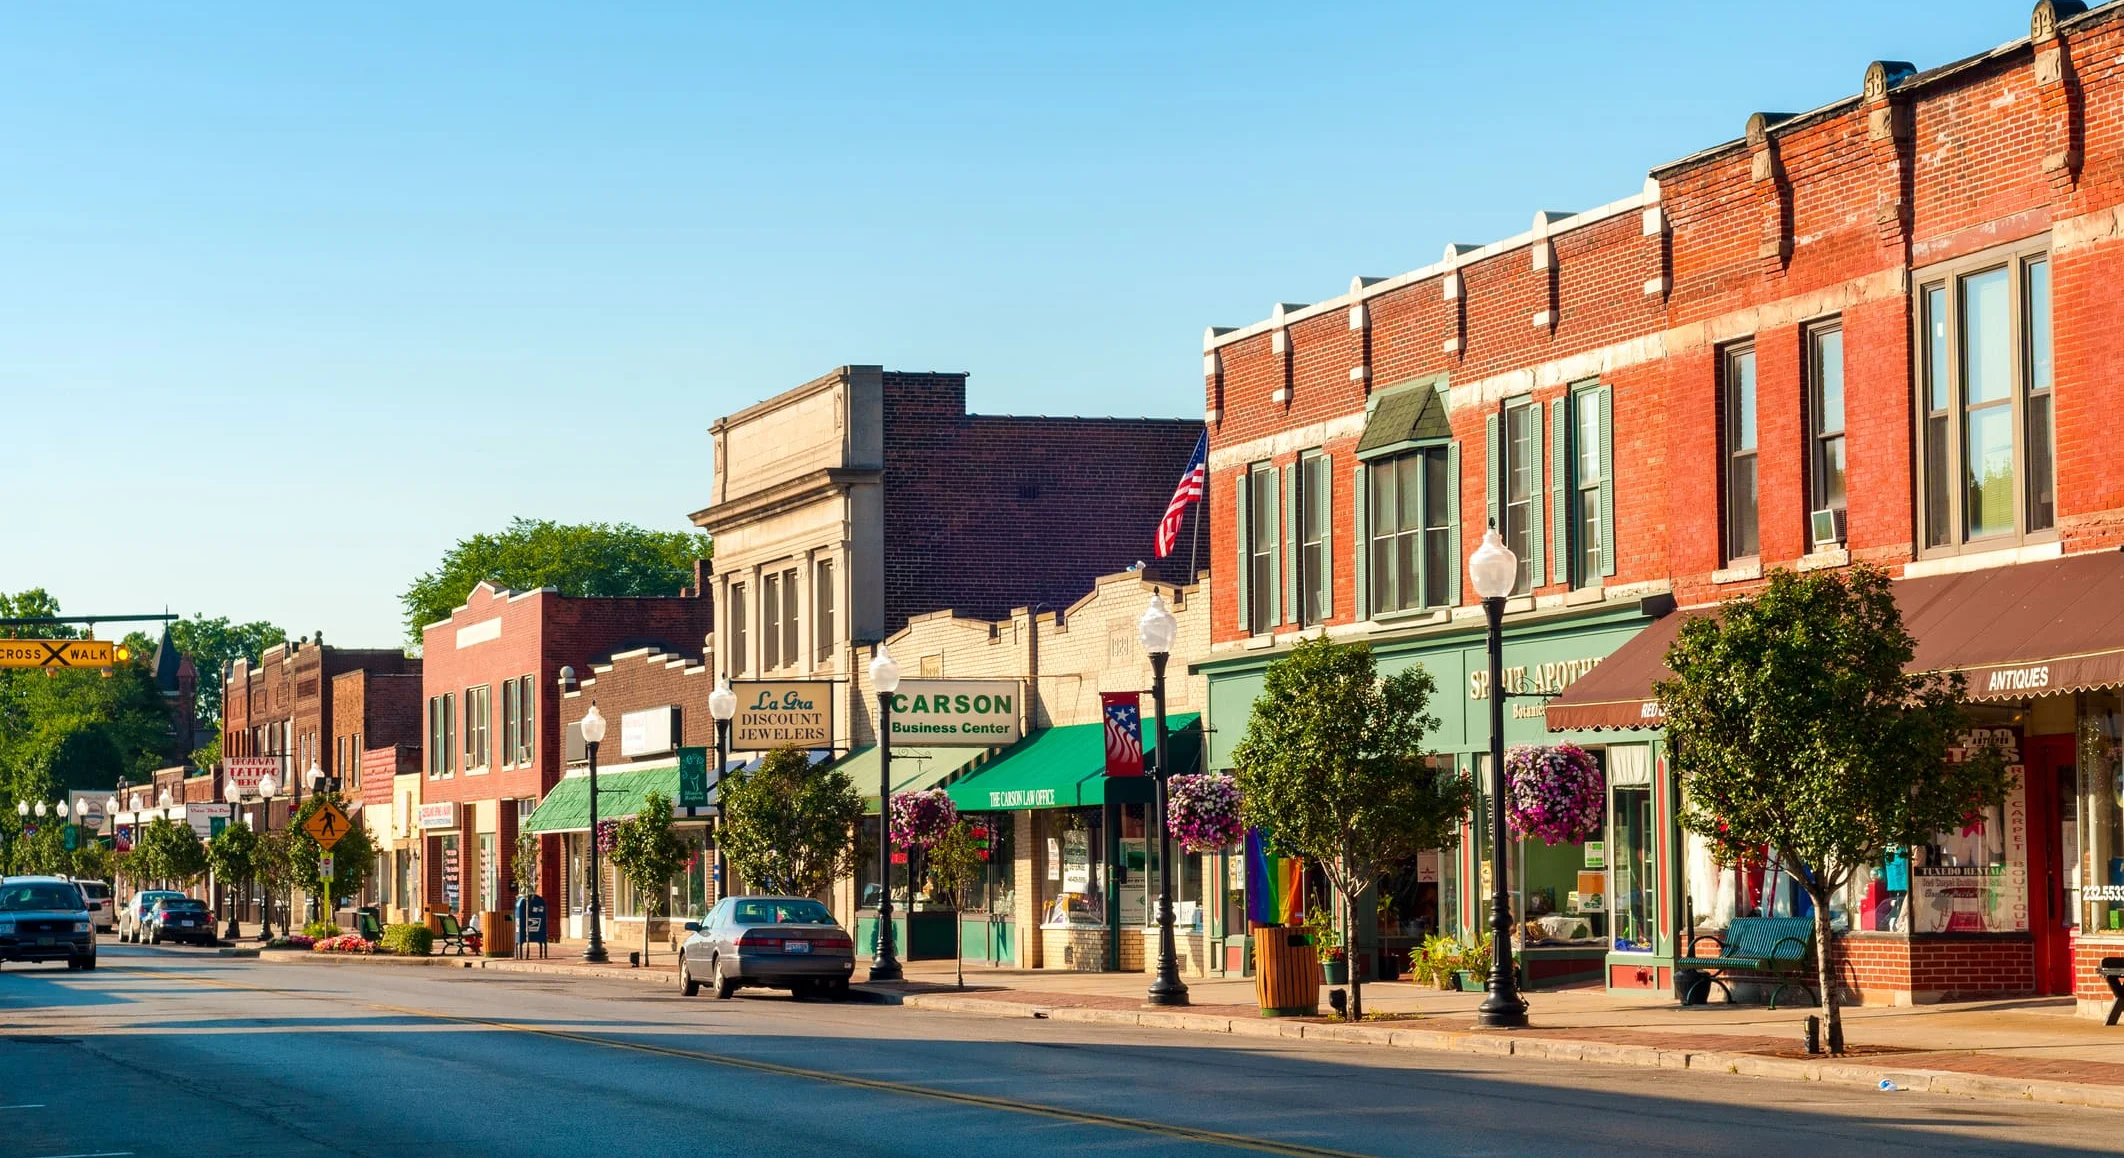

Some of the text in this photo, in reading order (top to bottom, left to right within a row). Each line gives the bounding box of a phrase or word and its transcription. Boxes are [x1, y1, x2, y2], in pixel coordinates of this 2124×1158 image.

[2031, 8, 2054, 38] 94
[70, 649, 108, 660] WALK
[1988, 665, 2049, 692] ANTIQUES
[750, 691, 813, 711] La Gra
[891, 694, 1012, 715] CARSON
[1640, 702, 1659, 718] RED
[742, 713, 822, 726] DISCOUNT
[738, 728, 825, 741] JEWELERS
[892, 722, 1011, 734] Business Center
[231, 758, 276, 766] BROADWAY
[228, 767, 280, 777] TATTOO
[990, 788, 1055, 807] THE CARSON LAW OFFICE
[2011, 800, 2024, 851] CARPET
[1922, 867, 2007, 876] TUXEDO RENTALS
[2012, 860, 2026, 928] BOUTIQUE
